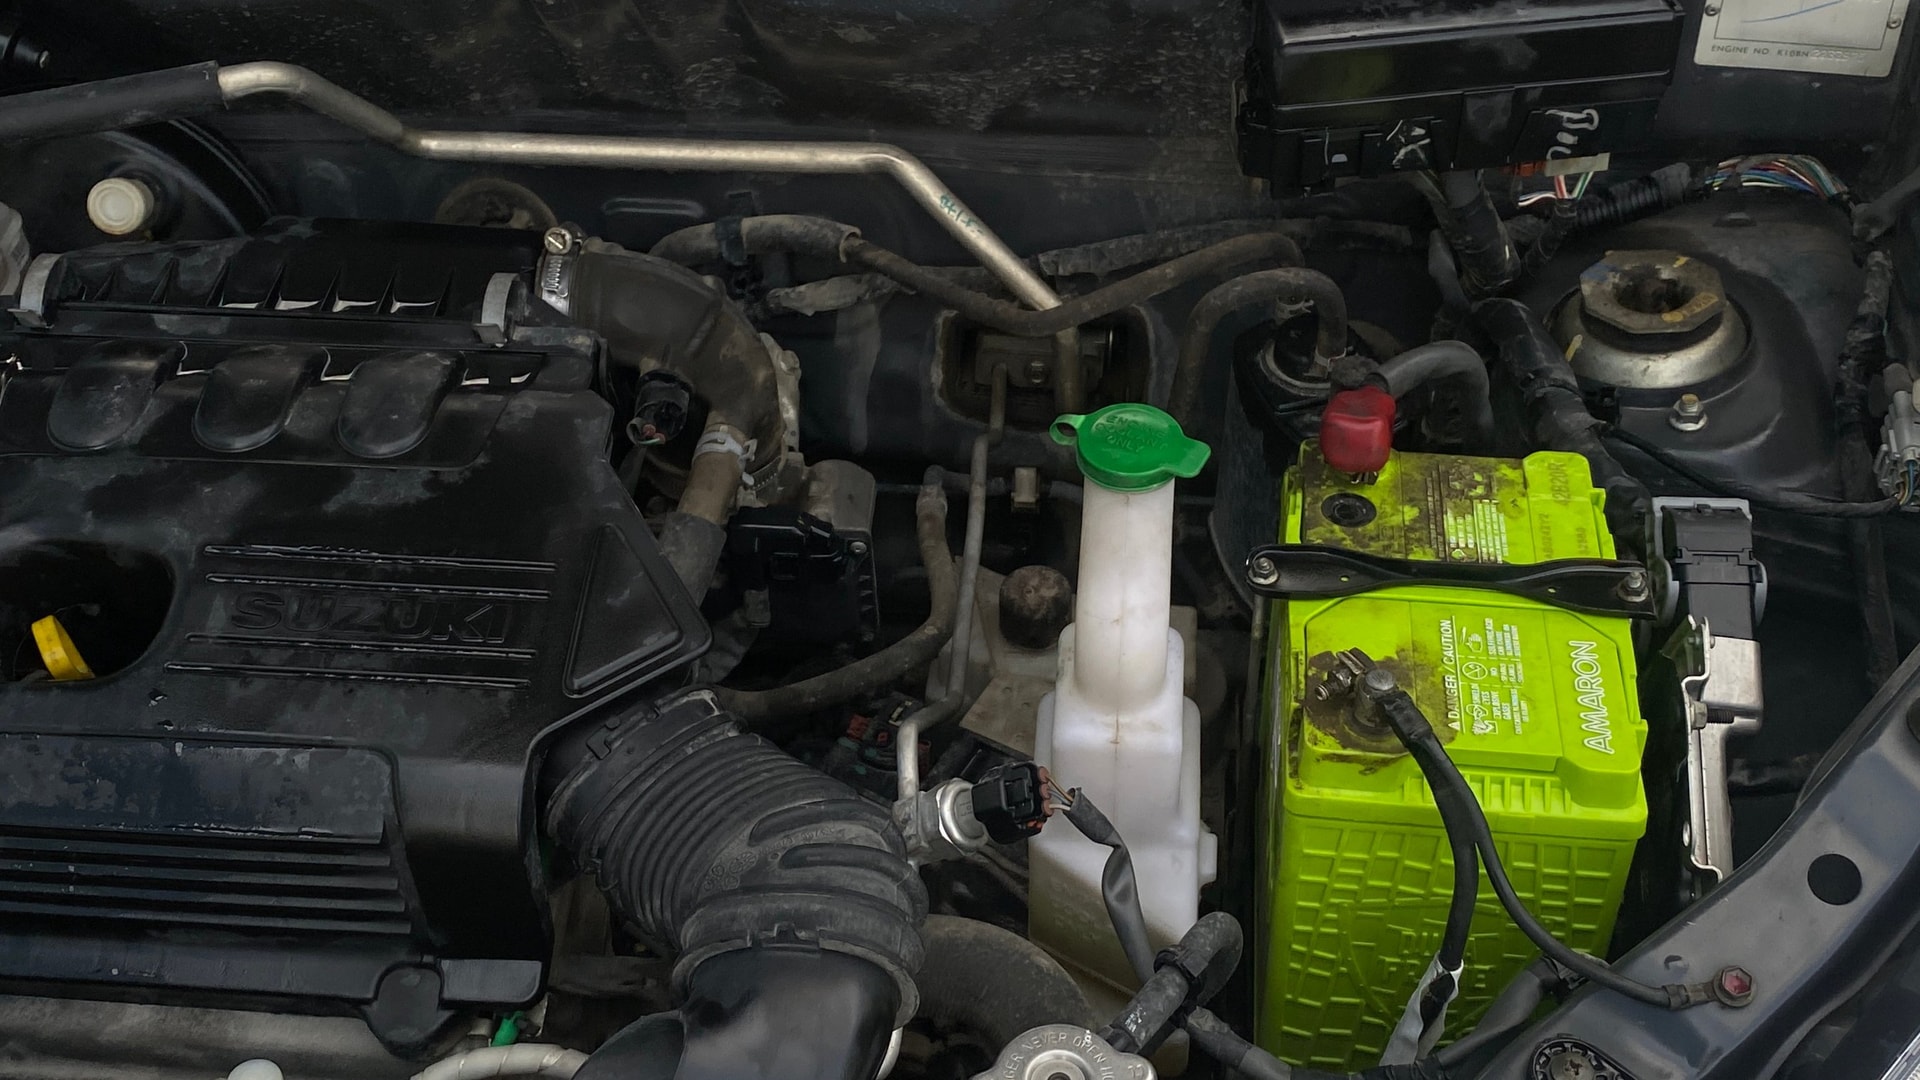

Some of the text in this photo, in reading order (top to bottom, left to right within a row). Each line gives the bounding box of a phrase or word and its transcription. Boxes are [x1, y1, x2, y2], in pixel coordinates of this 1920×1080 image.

[1711, 45, 1749, 54] ENGINE
[1106, 433, 1145, 453] ONLY
[231, 591, 512, 643] SUZUKI
[1440, 619, 1455, 665] CAUTION
[1444, 675, 1460, 719] DANGER
[1568, 640, 1616, 755] AMARON
[1022, 1032, 1067, 1050] NEVER
[1073, 1036, 1106, 1064] OPEN
